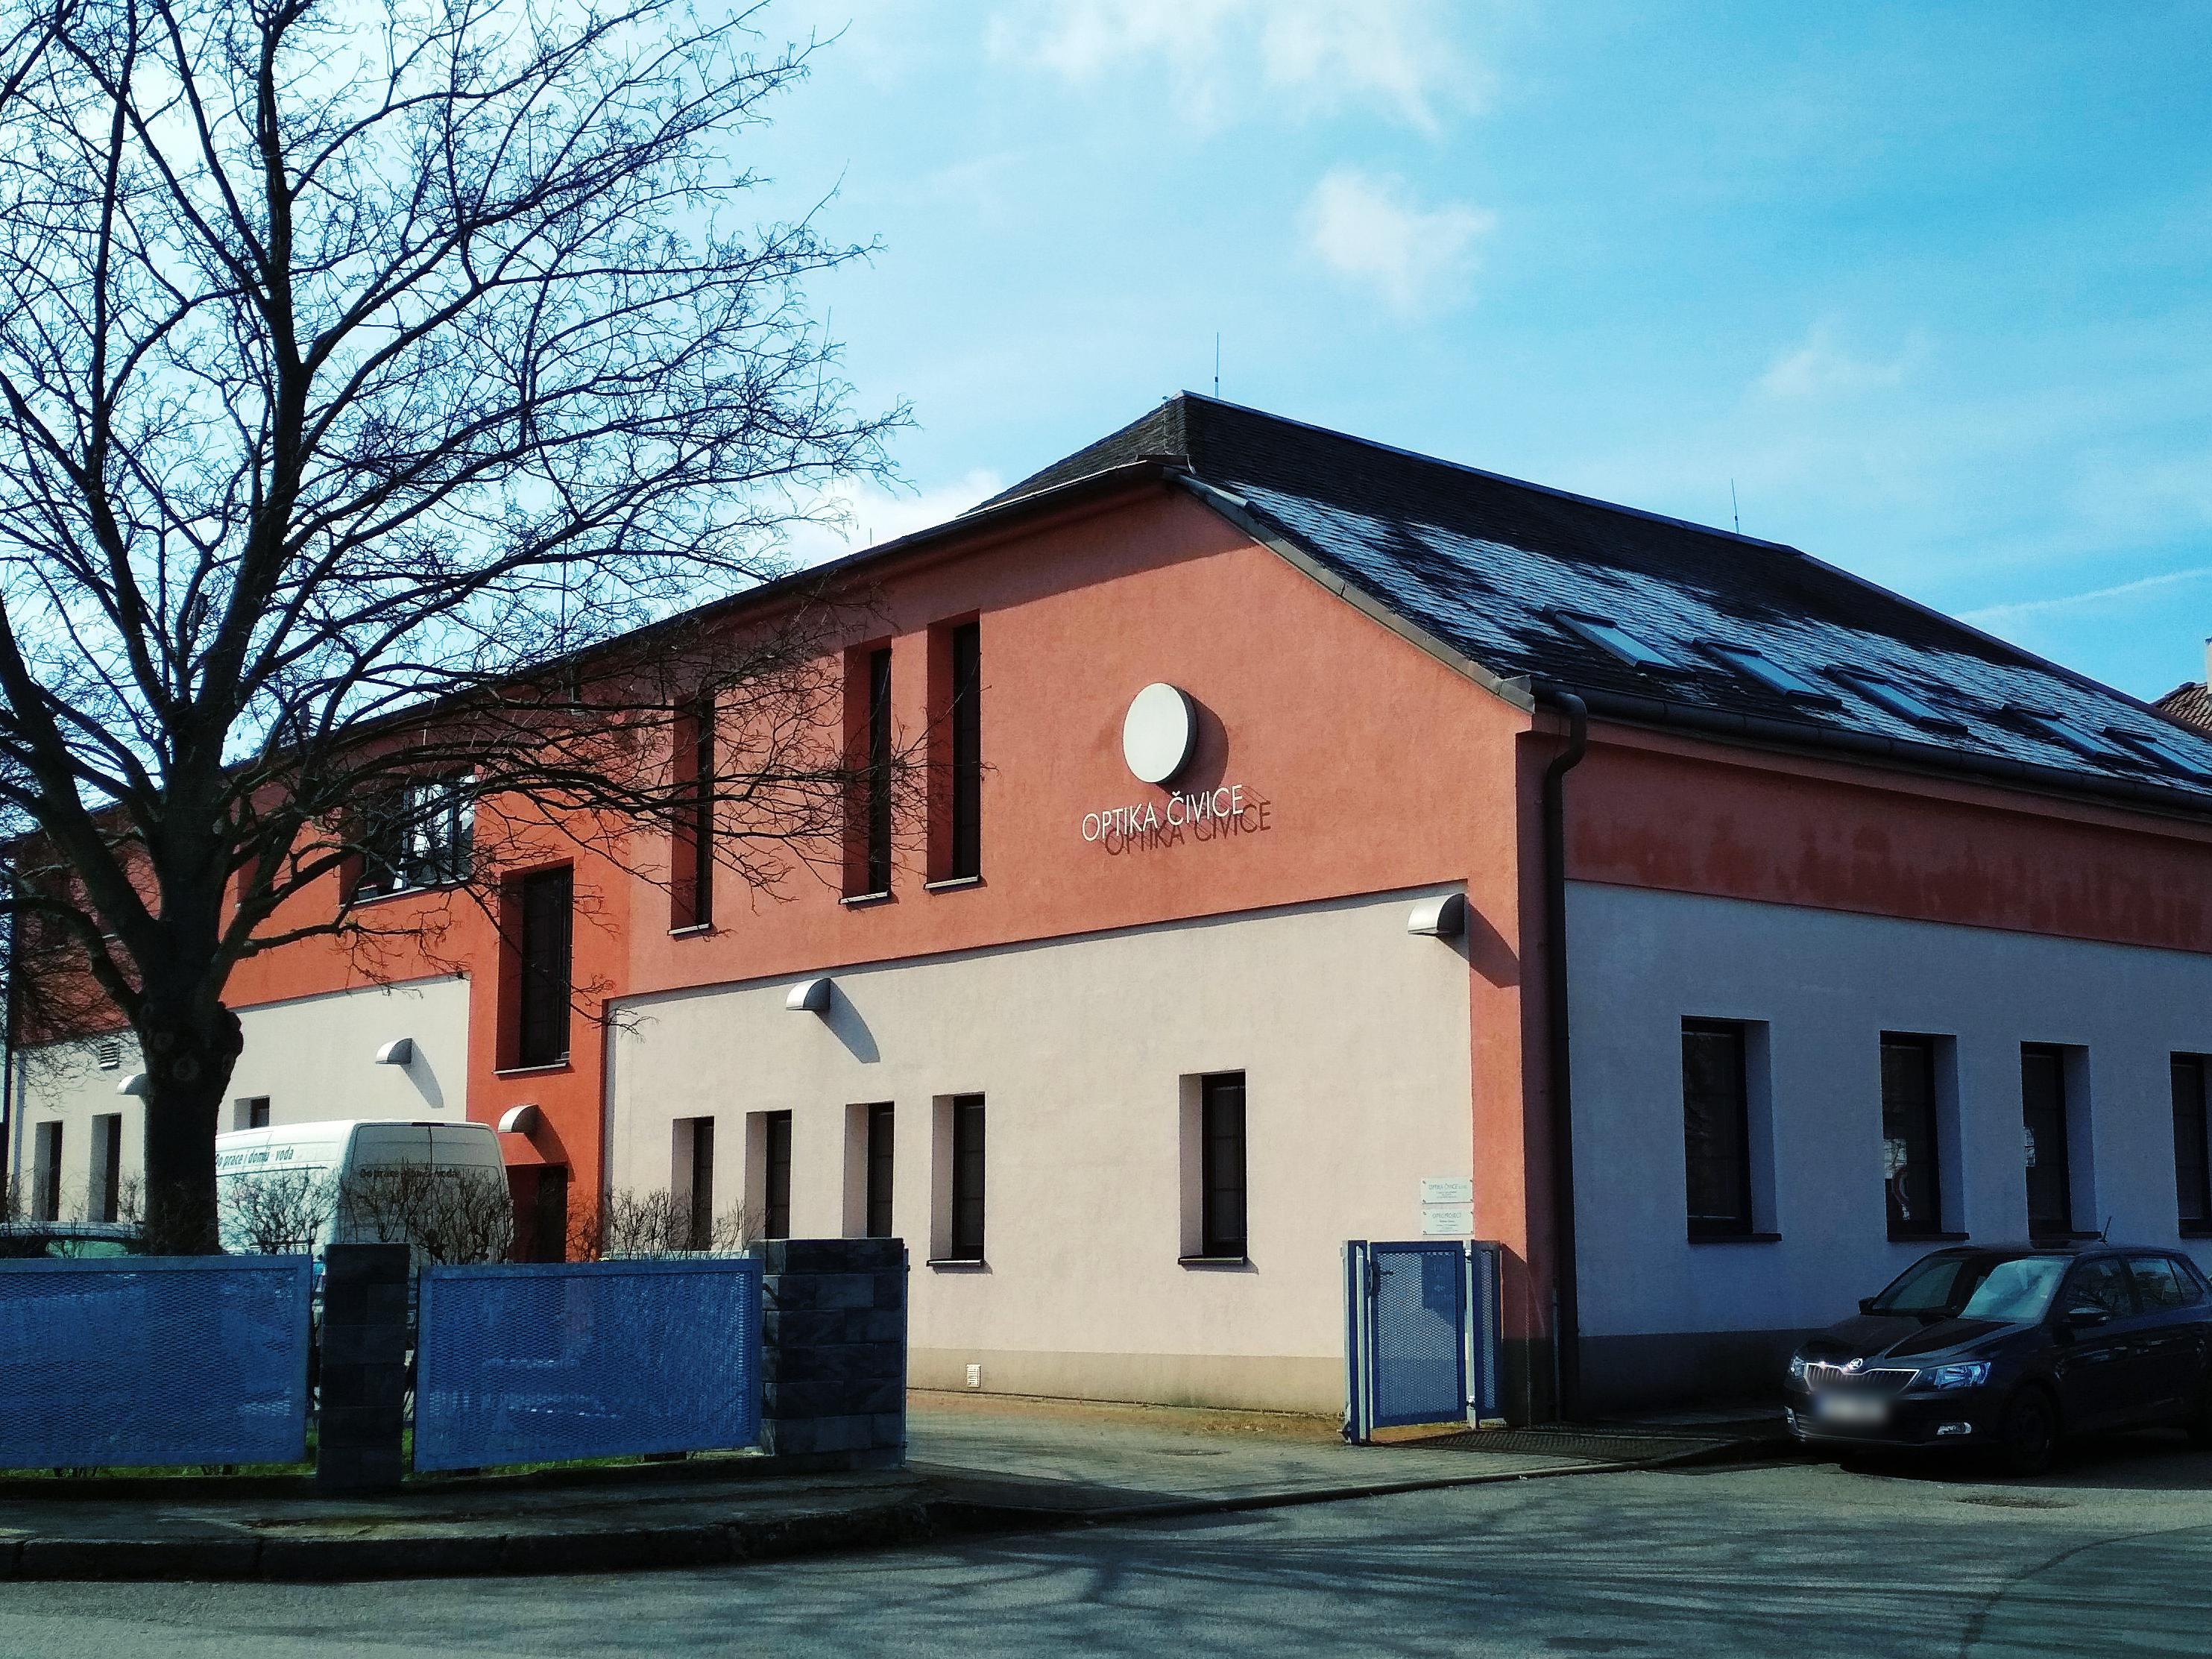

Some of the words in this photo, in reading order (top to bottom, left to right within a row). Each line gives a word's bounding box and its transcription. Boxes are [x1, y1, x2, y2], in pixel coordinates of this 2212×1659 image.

[1082, 802, 1159, 842] OPTIKA
[1166, 784, 1244, 826] ČIVICE
[275, 1145, 294, 1161] voda
